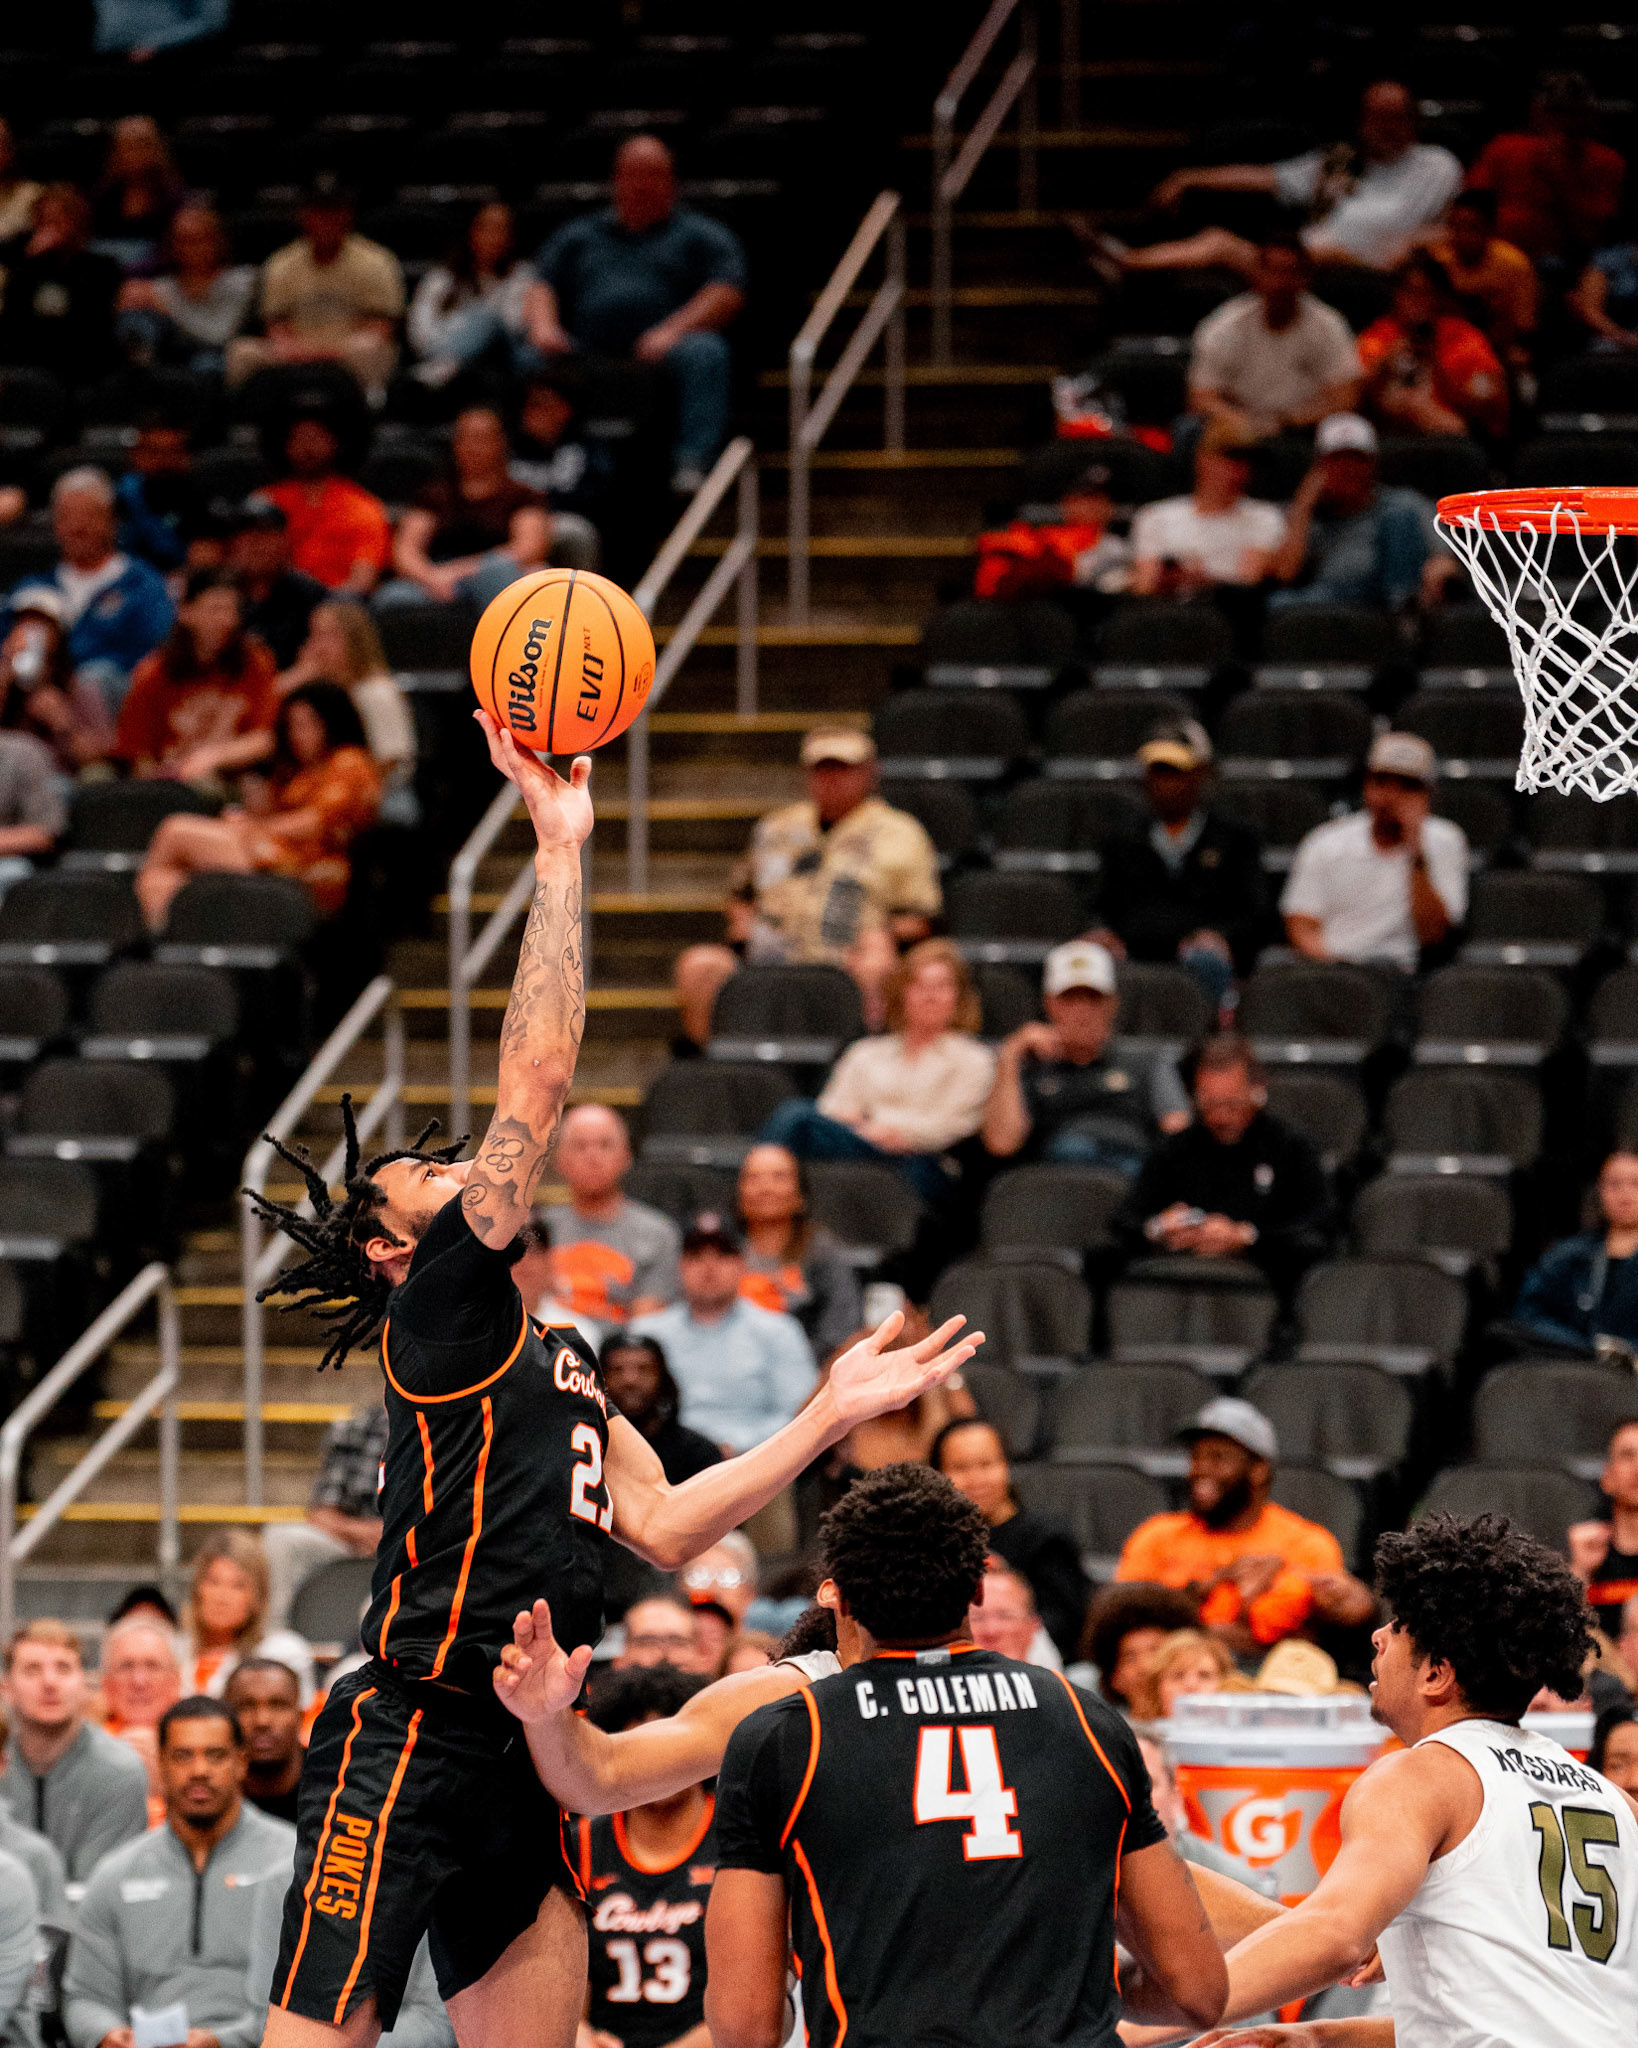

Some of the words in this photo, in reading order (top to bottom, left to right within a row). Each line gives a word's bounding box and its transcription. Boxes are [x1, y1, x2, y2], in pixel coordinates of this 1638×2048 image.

[508, 617, 553, 732] Wilson
[577, 653, 604, 722] EVO
[855, 1679, 889, 1720] C.
[896, 1671, 1038, 1715] COLEMAN
[912, 1724, 1023, 1862] 4
[1232, 1798, 1286, 1858] G
[315, 1812, 373, 1920] POKES
[1528, 1800, 1620, 1965] 15
[605, 1938, 692, 2004] 13
